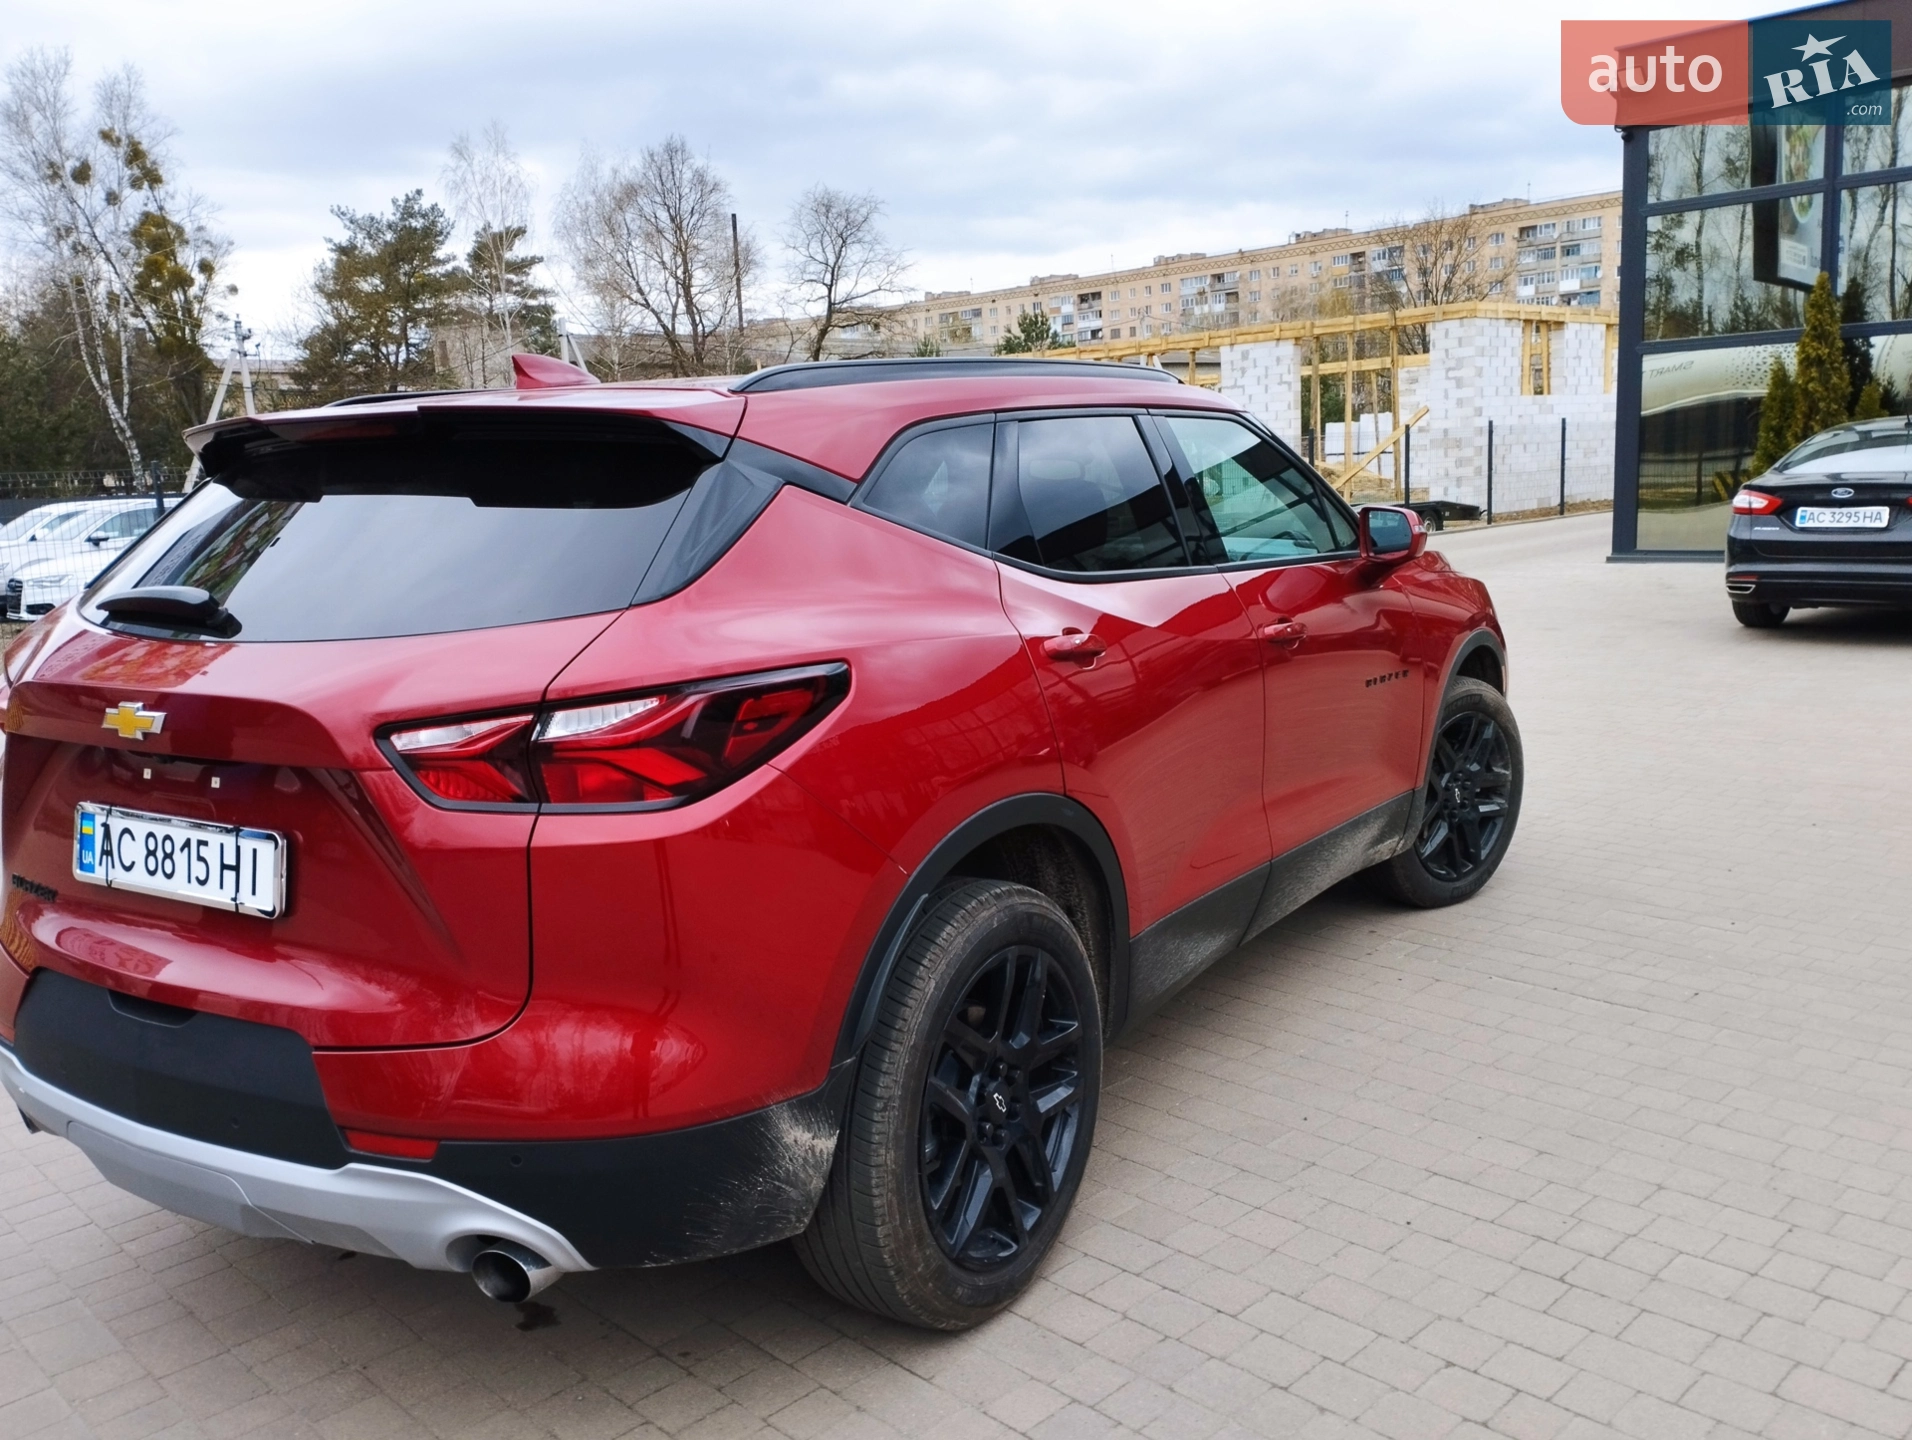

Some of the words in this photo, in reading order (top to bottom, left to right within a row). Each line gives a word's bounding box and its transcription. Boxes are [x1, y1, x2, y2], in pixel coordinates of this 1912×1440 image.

[1806, 511, 1826, 524] AC
[1829, 511, 1860, 524] 3295
[1863, 511, 1883, 524] HA
[82, 850, 94, 865] UA
[99, 822, 136, 872] AC
[144, 831, 210, 887] 8815
[219, 842, 257, 896] HI
